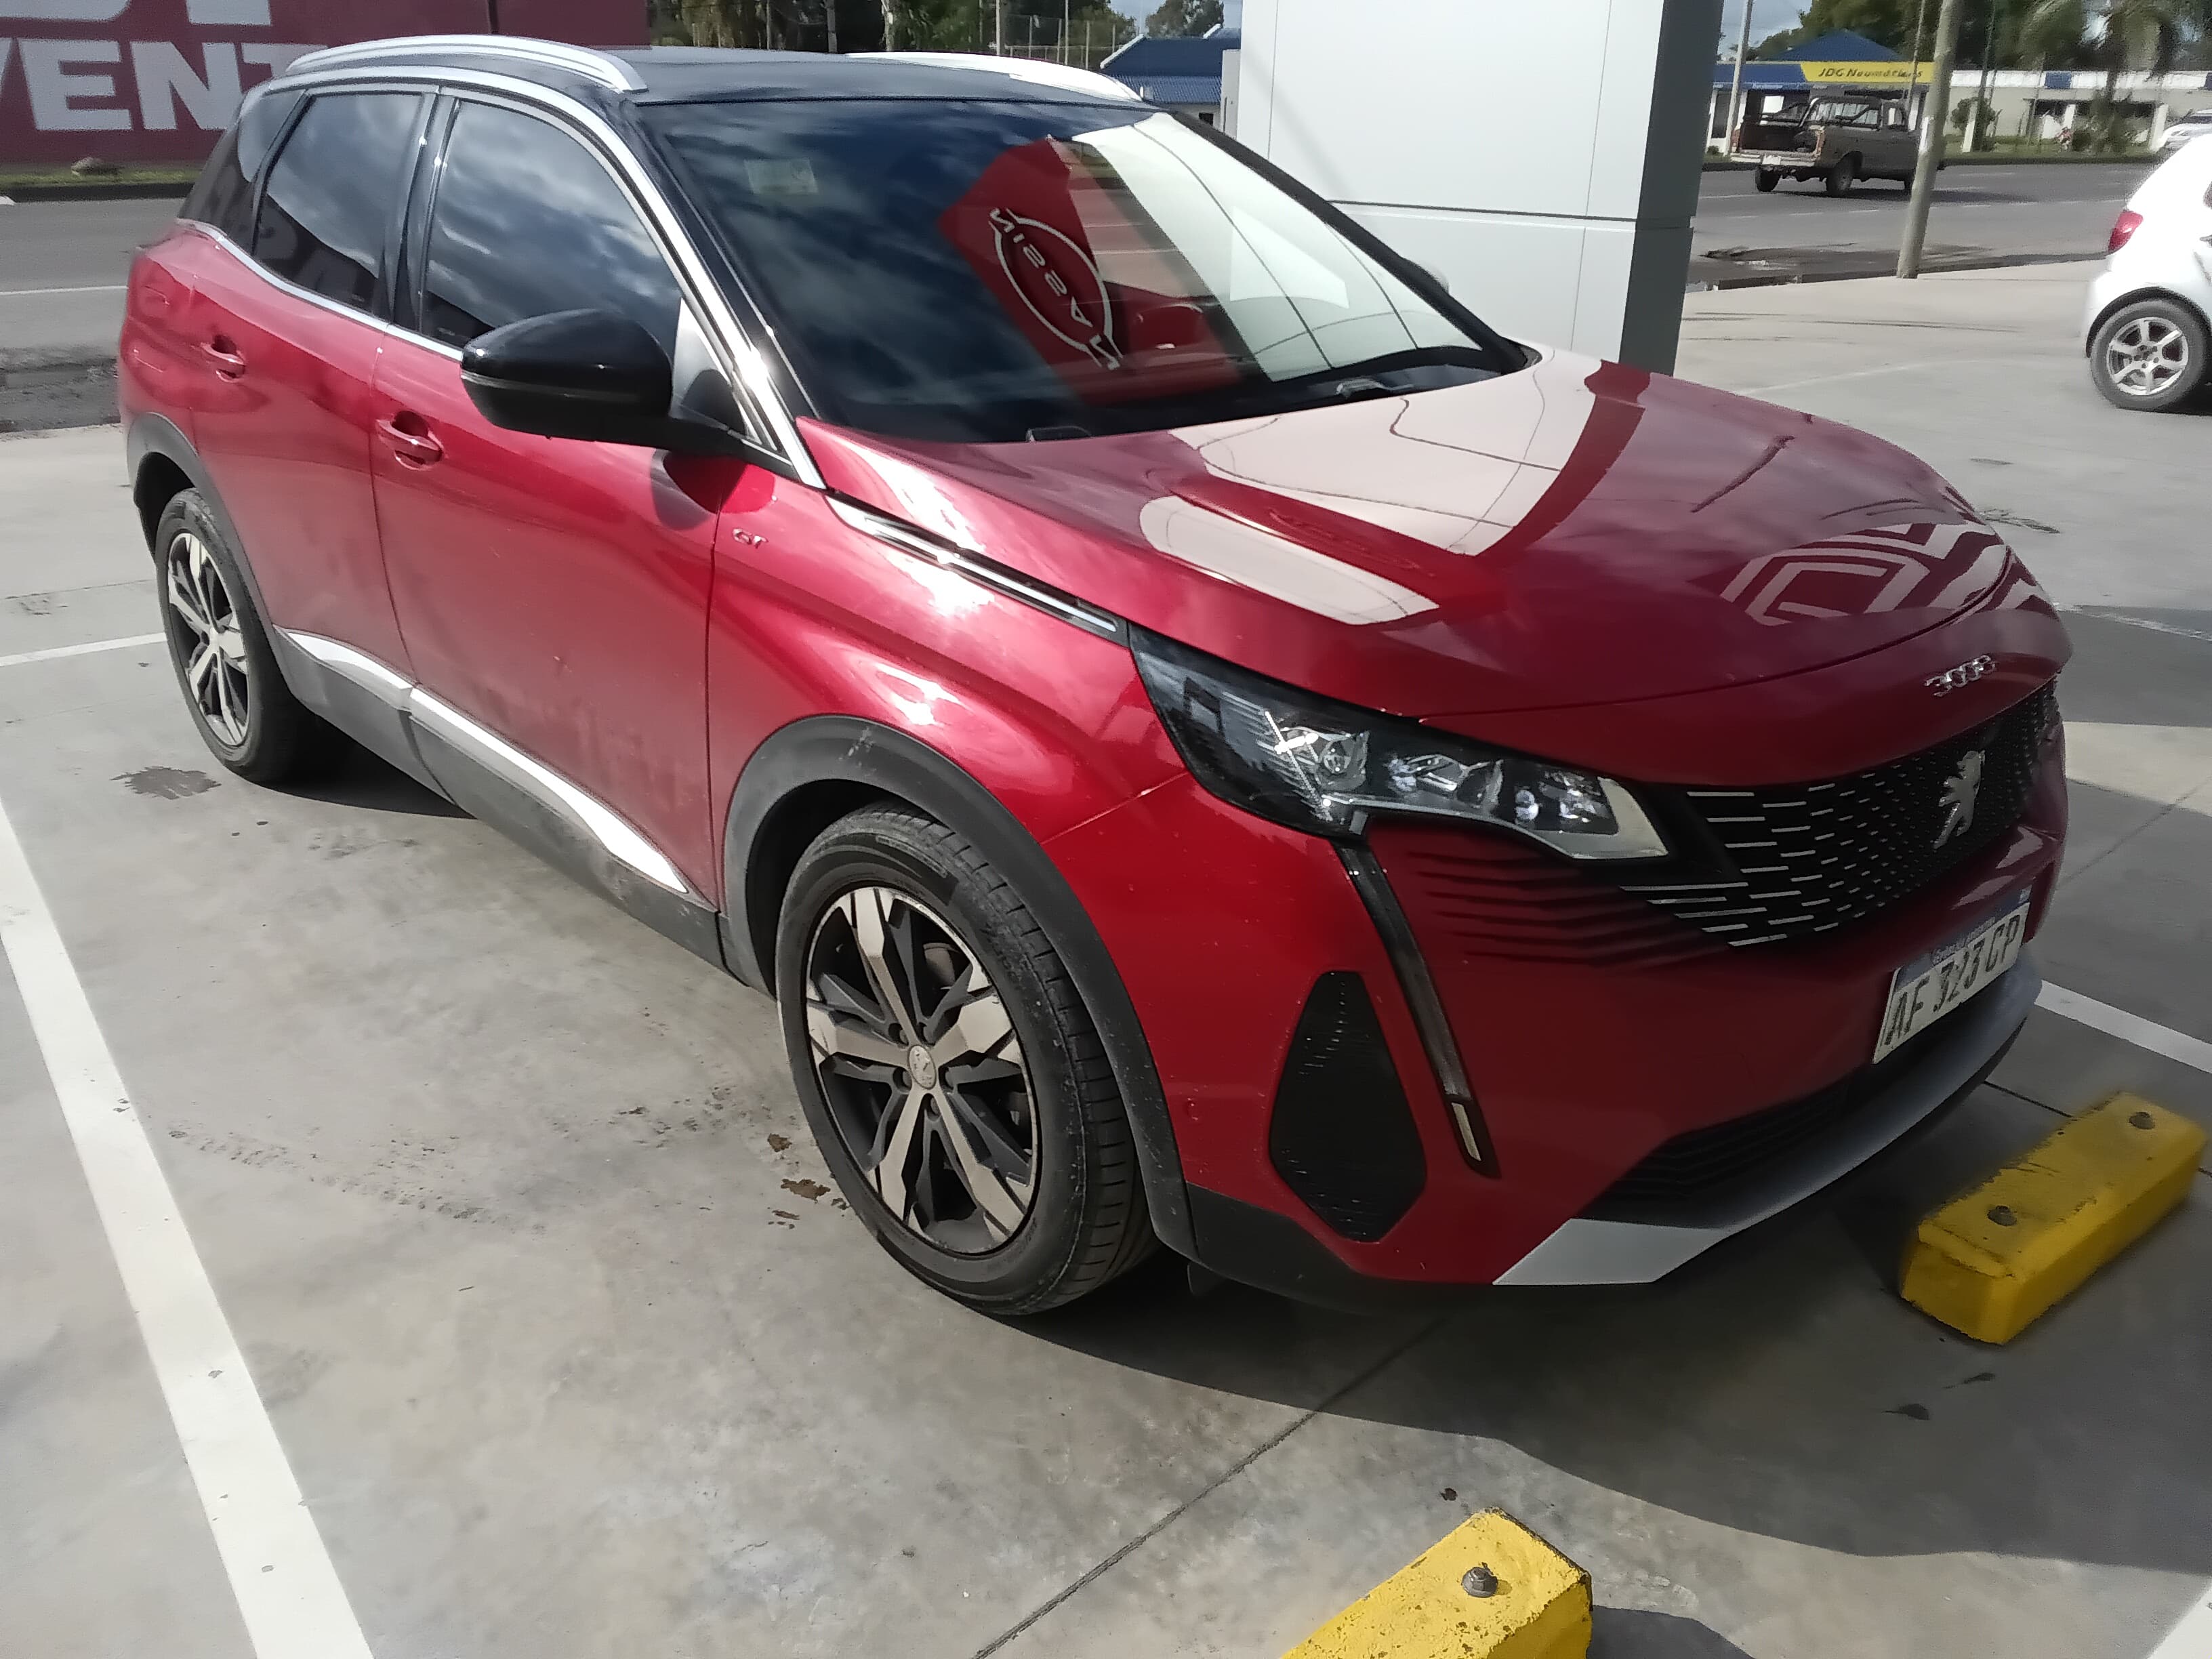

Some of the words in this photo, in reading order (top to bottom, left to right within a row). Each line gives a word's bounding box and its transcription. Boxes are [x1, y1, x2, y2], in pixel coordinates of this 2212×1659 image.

[0, 37, 329, 131] ENT
[1818, 68, 1844, 77] JDG
[733, 528, 769, 550] GT
[1924, 655, 1996, 697] 3008
[1884, 975, 1931, 1046] AF
